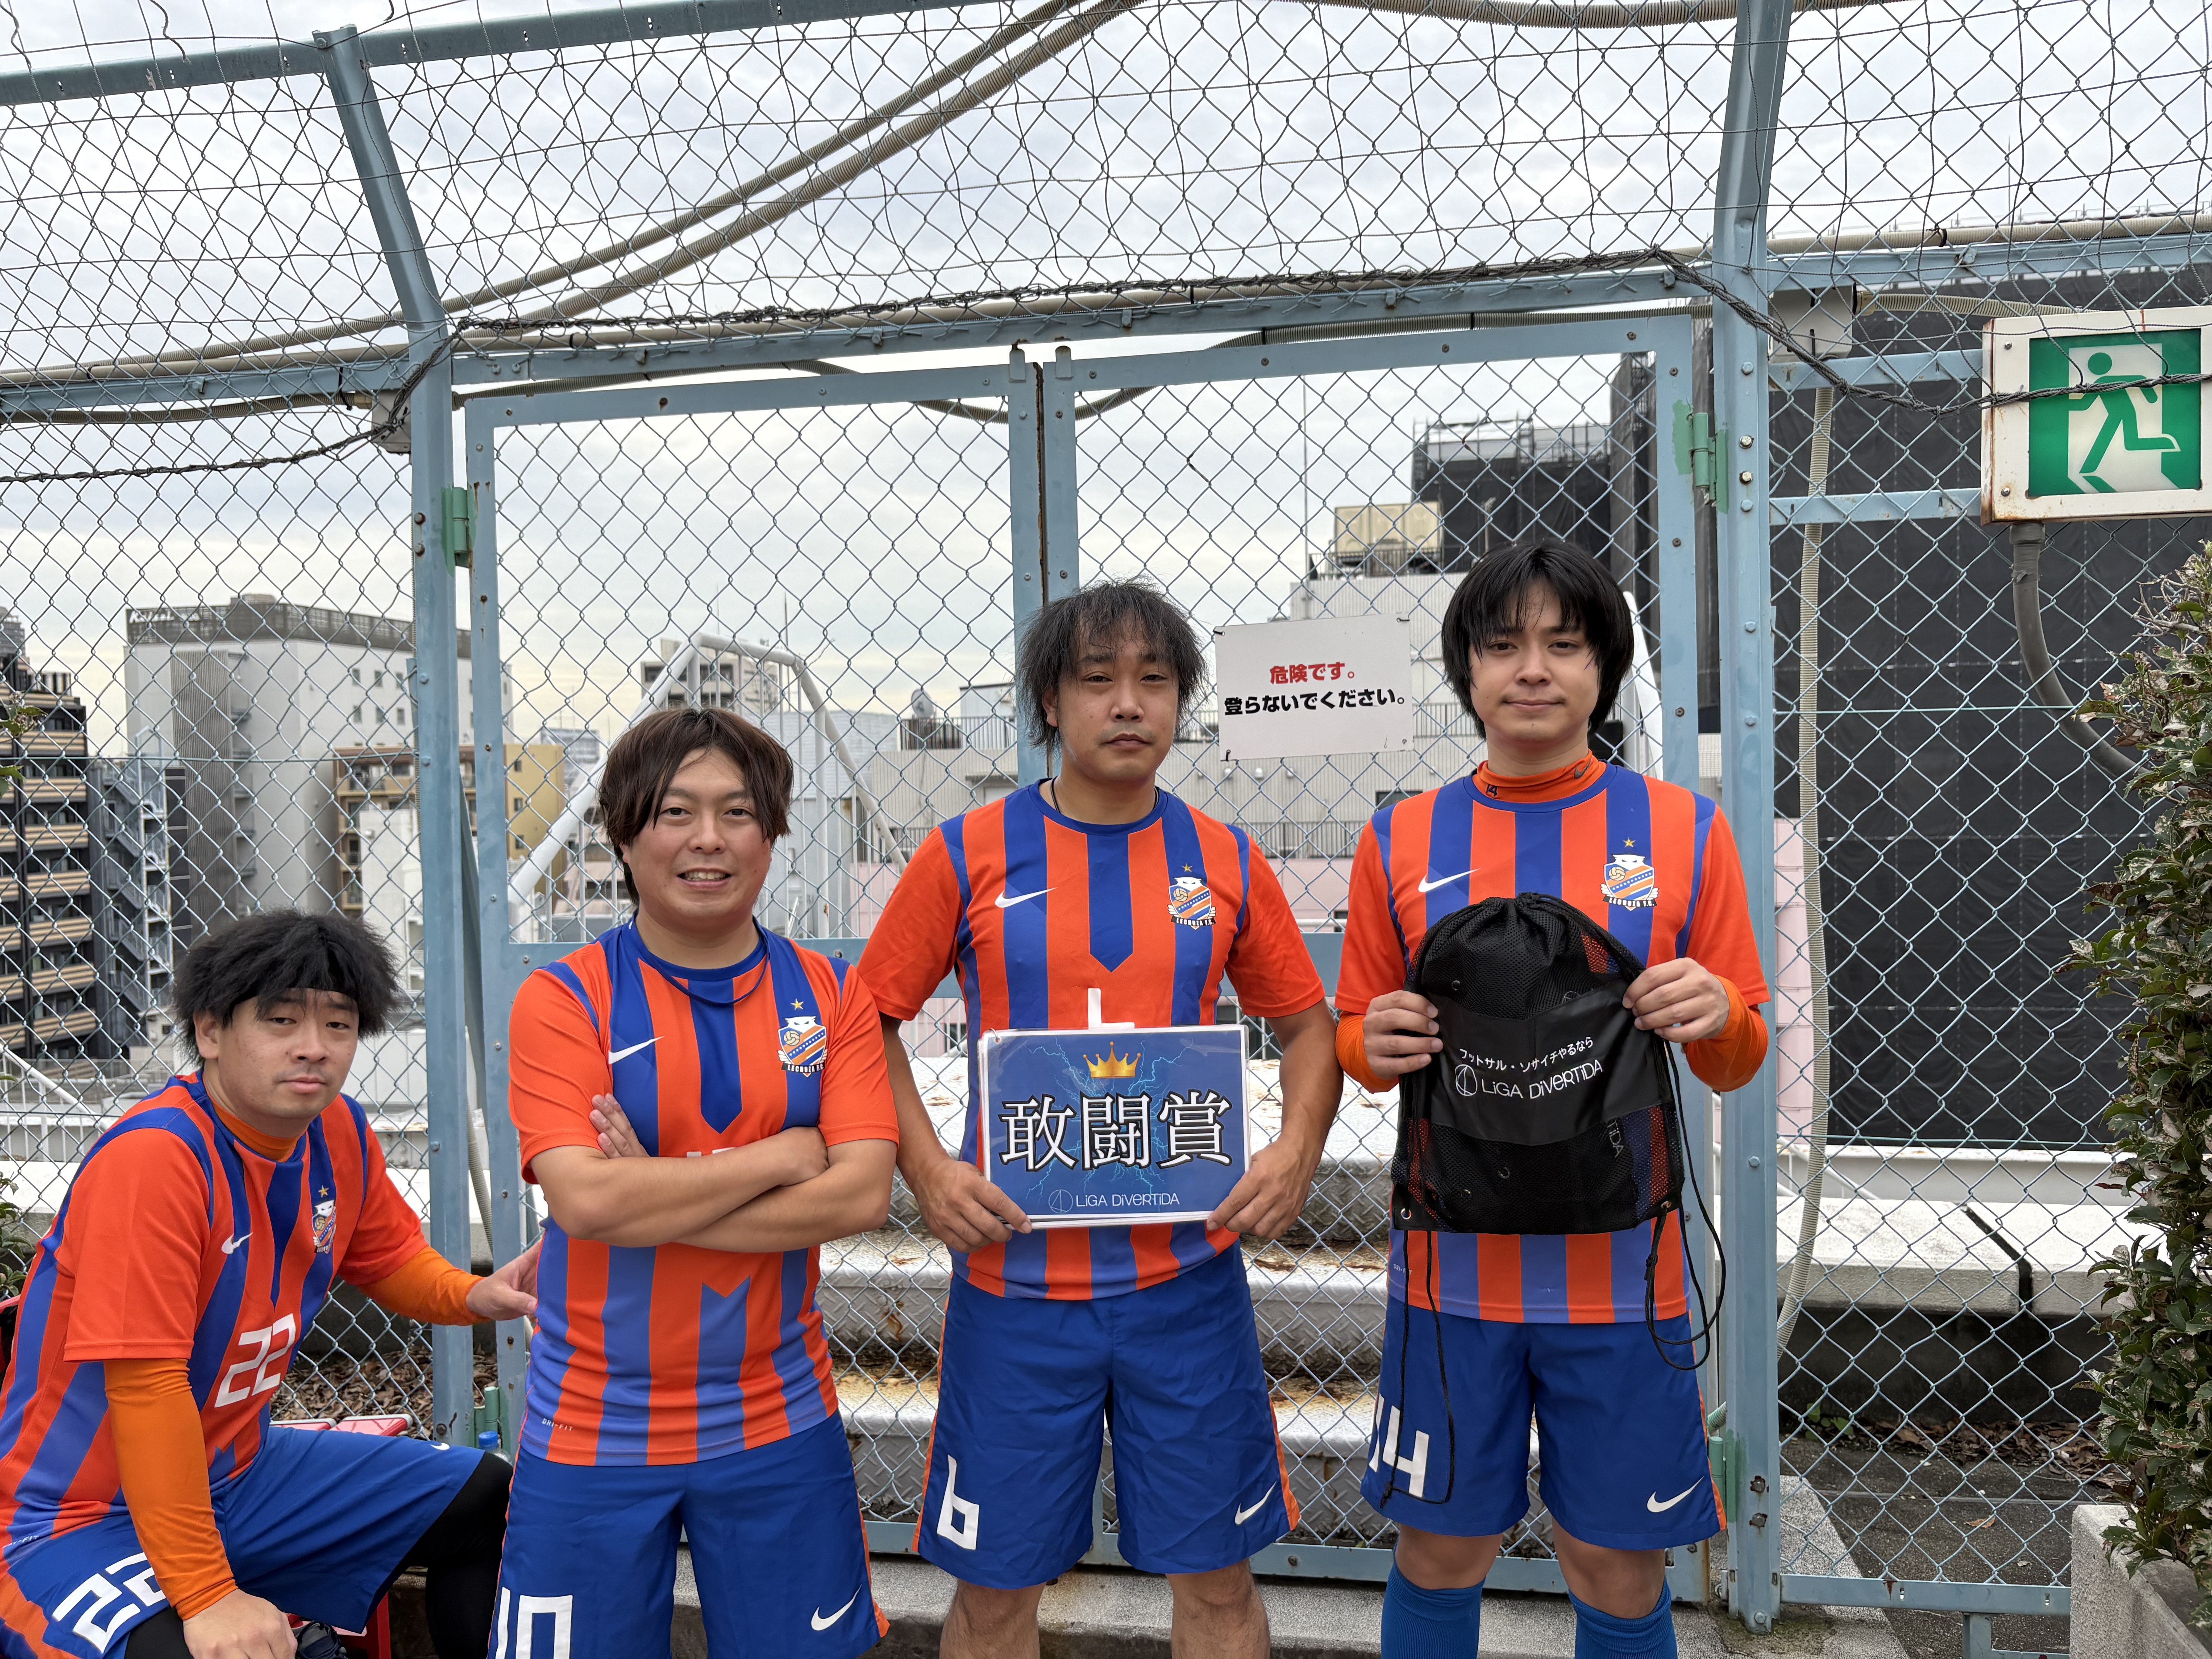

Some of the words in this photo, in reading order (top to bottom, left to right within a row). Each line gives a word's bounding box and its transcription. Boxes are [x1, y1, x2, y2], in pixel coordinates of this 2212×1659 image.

[1269, 661, 1355, 685] 危険です。
[1224, 688, 1405, 716] 登らないでください。
[787, 1064, 815, 1073] LECHUZA
[1460, 1036, 1593, 1073] フットサル・ソサイチやるなら
[998, 1089, 1233, 1172] 敢闘賞
[214, 1313, 296, 1408] 22
[542, 1417, 574, 1431] DRI-FIT
[1369, 1393, 1429, 1498] 14
[52, 1552, 167, 1654] 22
